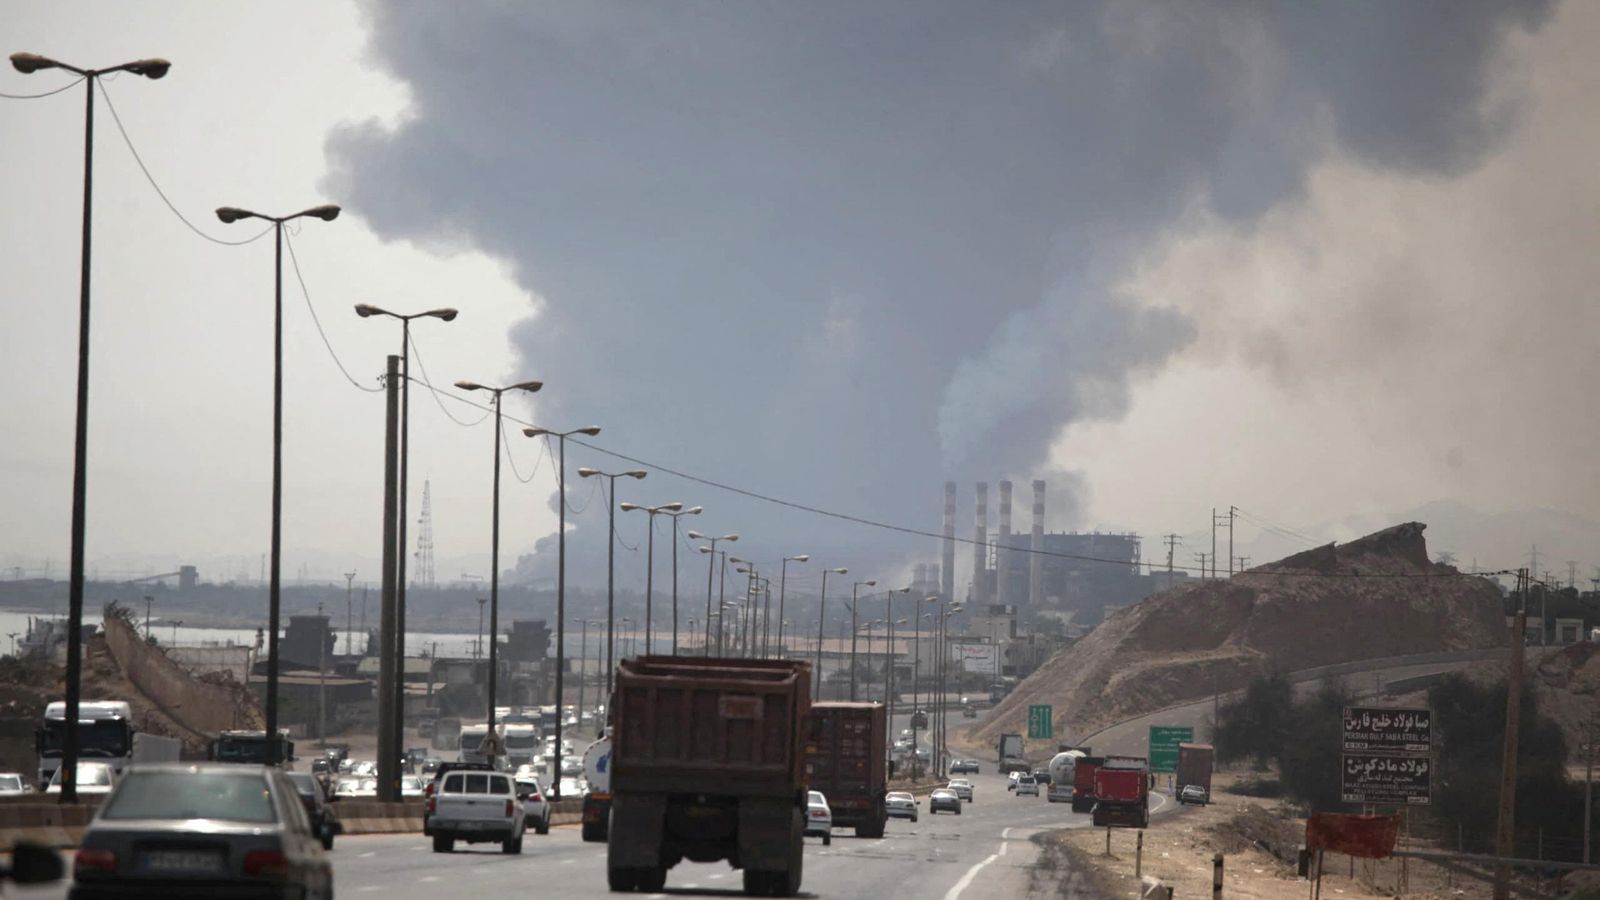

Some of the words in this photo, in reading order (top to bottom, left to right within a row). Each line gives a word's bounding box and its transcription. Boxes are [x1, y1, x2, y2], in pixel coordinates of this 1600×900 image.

[1345, 712, 1371, 730] فارس
[1371, 713, 1391, 732] خلیج
[1393, 713, 1414, 732] فولاد
[1415, 714, 1429, 731] صبا
[1344, 731, 1368, 740] PERSIAN
[1369, 732, 1384, 741] GULF
[1402, 733, 1419, 742] STEEL
[1399, 759, 1428, 777] فولاد
